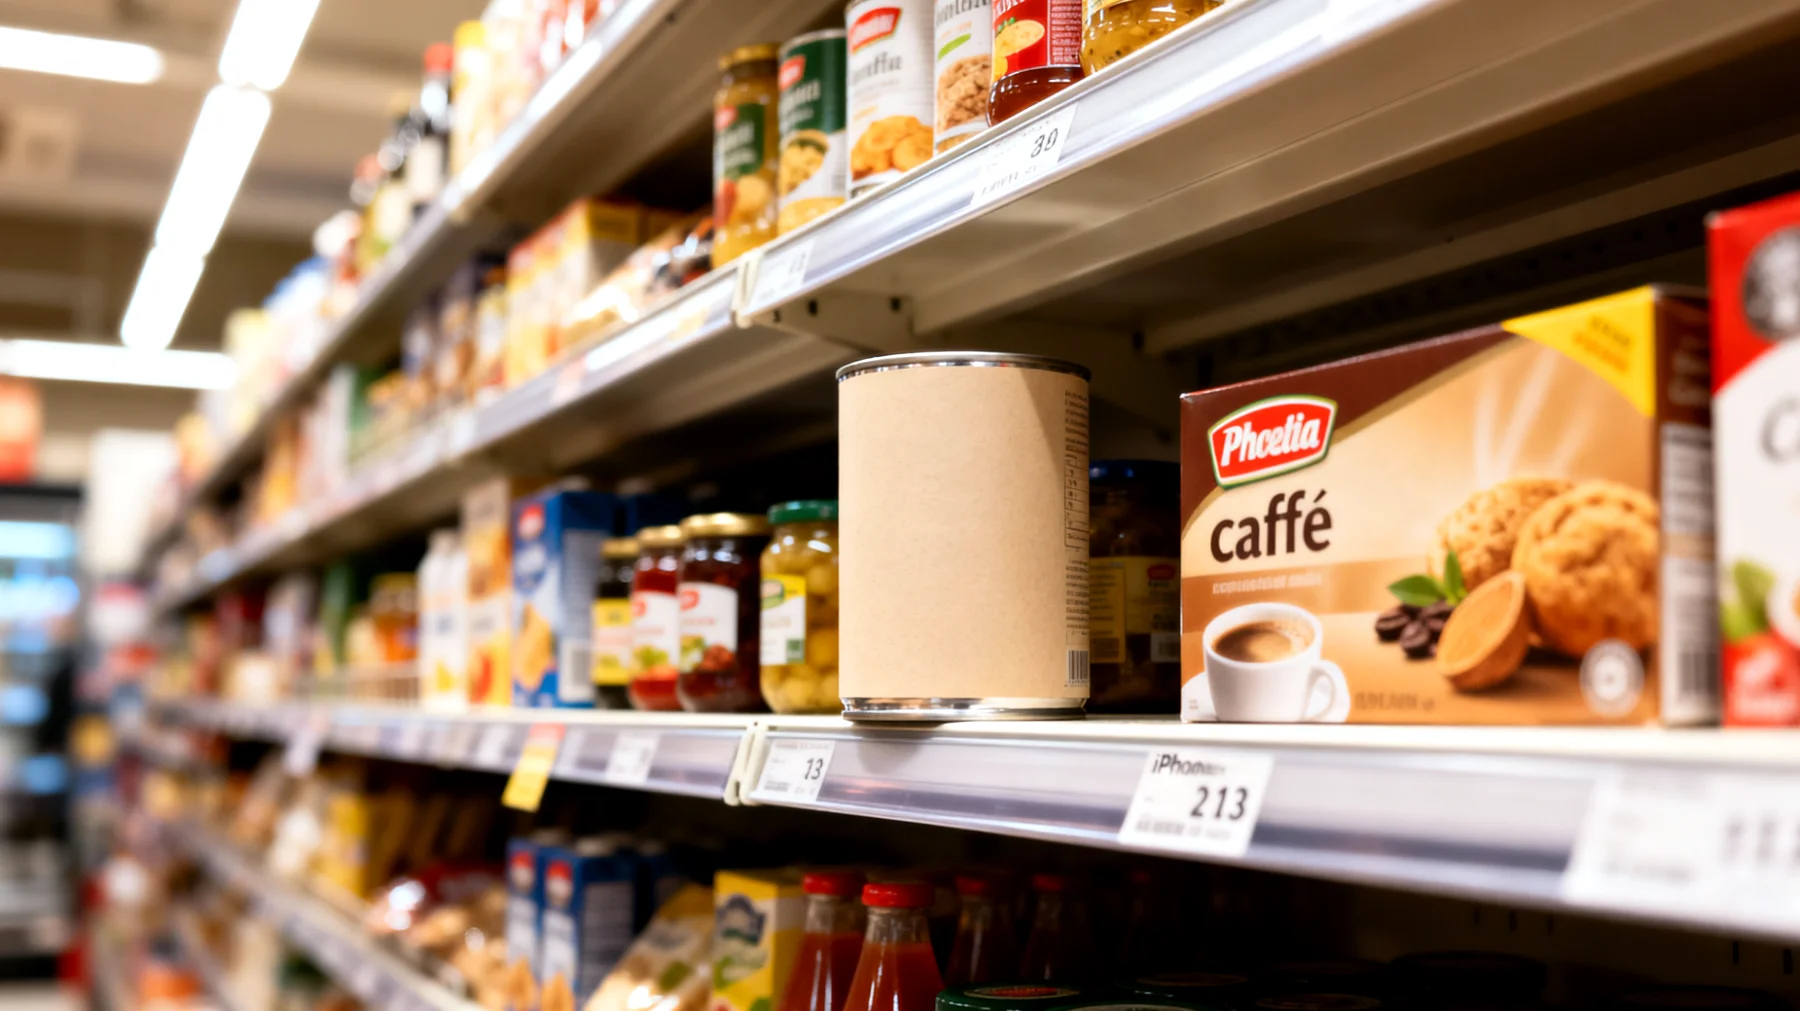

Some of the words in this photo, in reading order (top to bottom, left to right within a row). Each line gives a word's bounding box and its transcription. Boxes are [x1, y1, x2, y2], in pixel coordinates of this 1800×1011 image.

[1210, 489, 1332, 563] caffé
[804, 757, 824, 780] 13
[1190, 785, 1249, 820] 213
